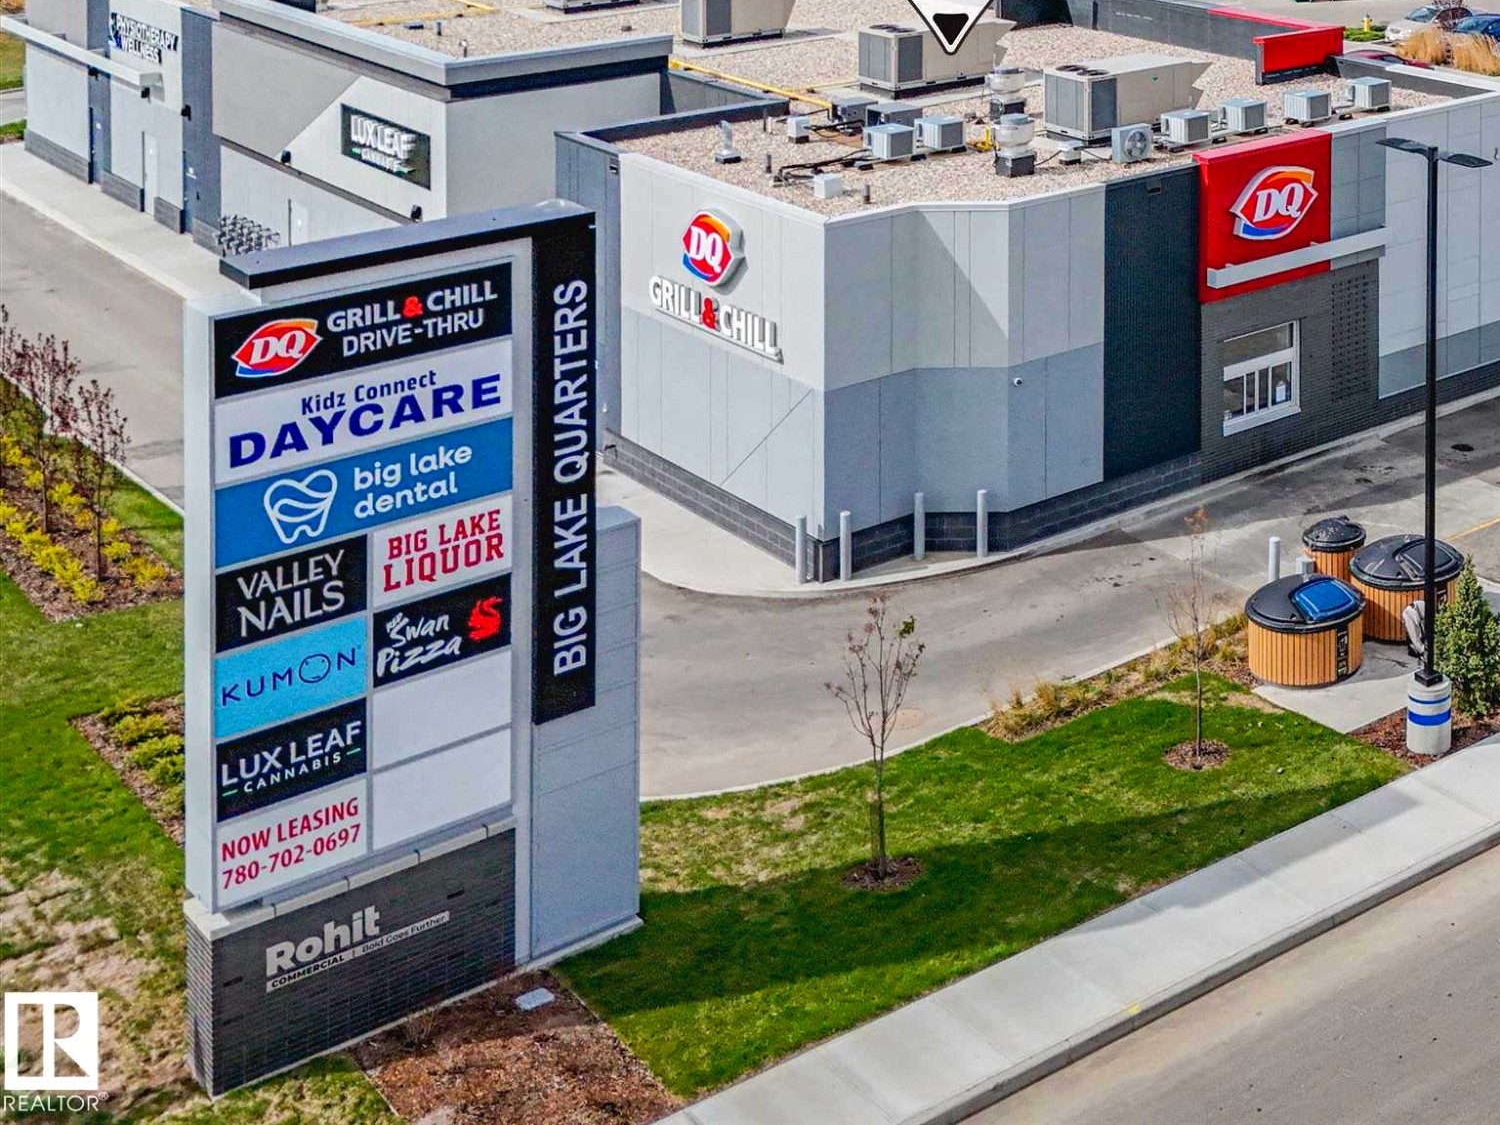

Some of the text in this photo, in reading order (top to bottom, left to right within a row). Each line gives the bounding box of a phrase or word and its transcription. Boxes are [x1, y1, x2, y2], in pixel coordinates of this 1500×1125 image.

[351, 115, 416, 160] LUX LEAF
[1253, 182, 1304, 223] DQ
[690, 225, 723, 273] DQ
[327, 280, 497, 333] GRILL & CHILL
[650, 276, 777, 355] GRILL & CHILL
[249, 330, 306, 365] DQ
[342, 308, 484, 357] DRIVE-THRU
[301, 369, 437, 416] Kidz Connect
[229, 374, 501, 469] DAYCARE
[353, 446, 473, 492] big lake
[554, 279, 588, 676] BIG LAKE QUARTERS
[353, 478, 458, 520] dental
[387, 509, 502, 561] BIG LAKE
[237, 549, 345, 600] VALLEY
[383, 531, 505, 593] LIQUOR
[237, 580, 345, 637] NAILS
[389, 615, 450, 648] Swan
[222, 647, 356, 706] KUMON
[376, 636, 462, 678] Pizza
[221, 720, 362, 787] LUX LEAF
[244, 752, 342, 793] CANNABIS
[221, 797, 359, 862] NOW LEASING
[222, 823, 361, 890] 780-702-0697
[266, 905, 380, 977] Rohit
[271, 954, 345, 988] COMMERCIAL
